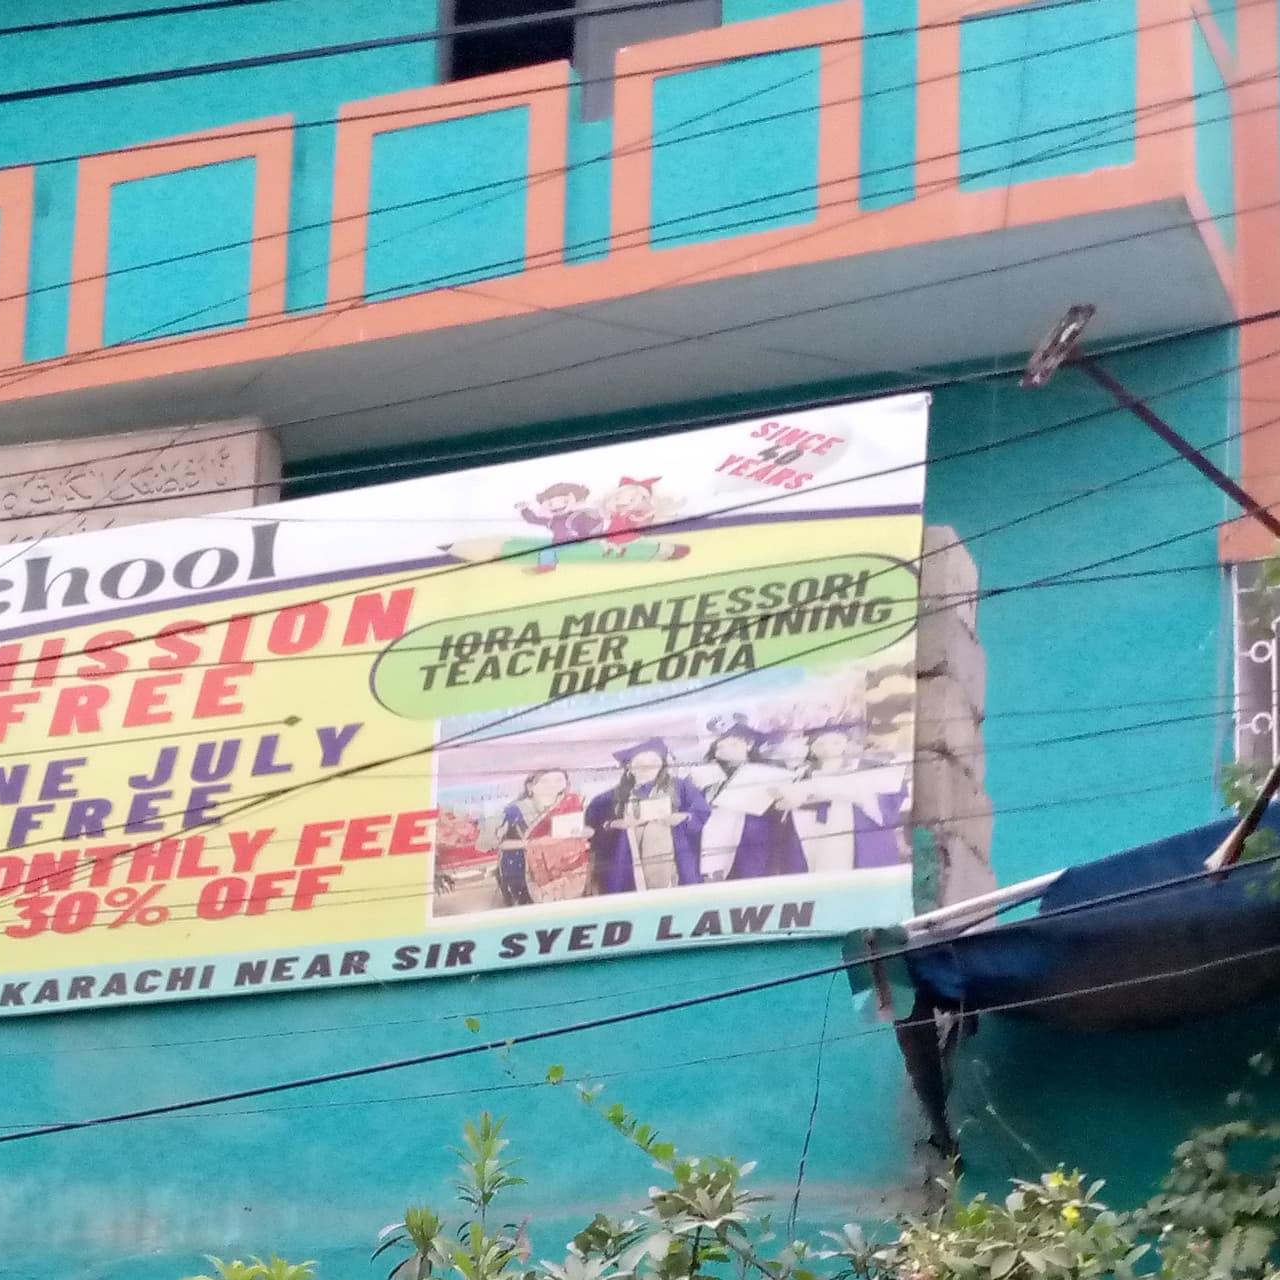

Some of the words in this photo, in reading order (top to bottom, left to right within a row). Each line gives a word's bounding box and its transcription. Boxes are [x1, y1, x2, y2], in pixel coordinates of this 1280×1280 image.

[715, 454, 814, 490] YEARS
[751, 422, 845, 456] SINCE
[558, 570, 871, 641] MONTESSORI
[419, 634, 630, 692] TEACHER
[660, 596, 894, 653] TRAINING
[547, 643, 756, 701] DIPLOMA
[128, 722, 364, 793] JULY
[5, 784, 235, 849] FREE
[292, 807, 441, 868] FEE
[4, 882, 170, 939] 30%
[194, 864, 343, 921] OFF
[233, 948, 371, 987] NEAR
[391, 938, 475, 971] SIR
[498, 918, 633, 960] SYED
[655, 901, 816, 941] LAWN
